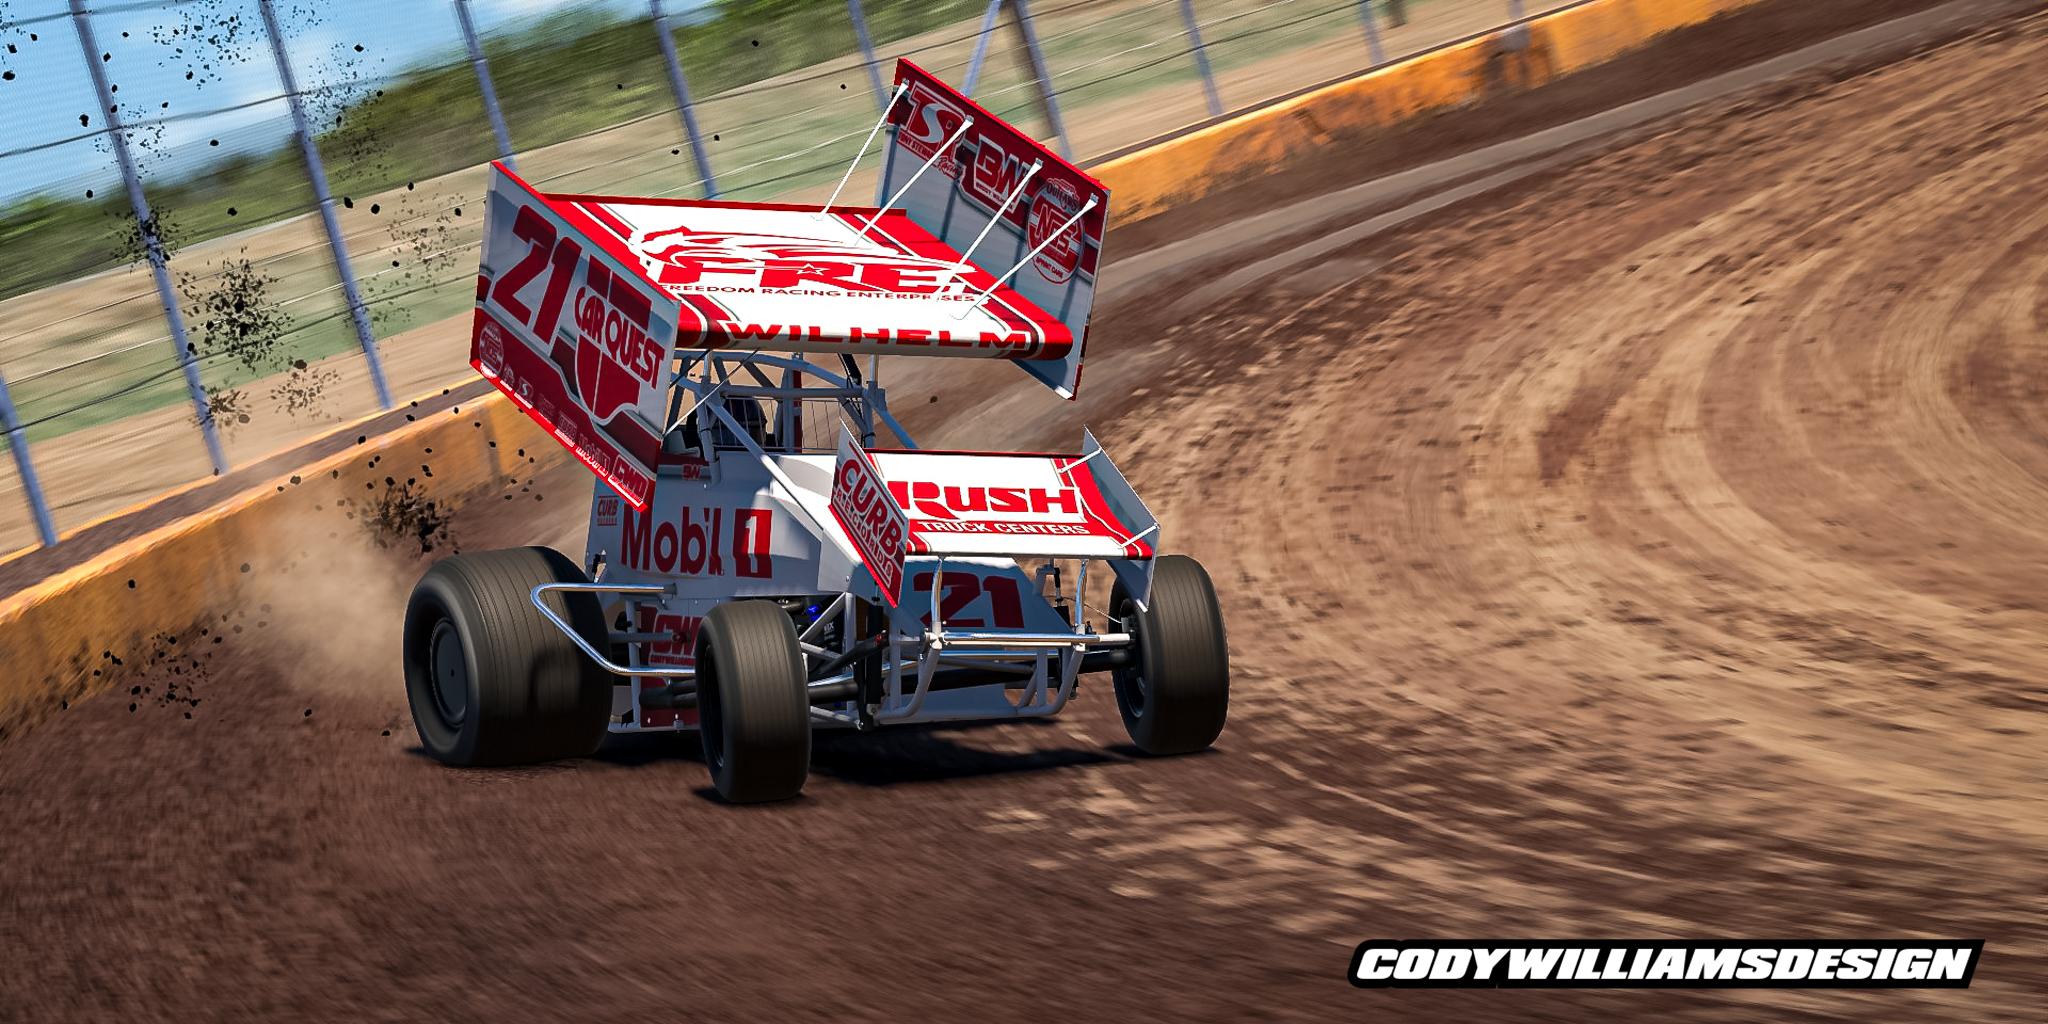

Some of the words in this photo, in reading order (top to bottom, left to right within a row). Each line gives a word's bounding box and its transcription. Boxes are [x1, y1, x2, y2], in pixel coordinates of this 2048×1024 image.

[492, 204, 583, 345] 21
[661, 284, 755, 294] FREEDOM
[762, 287, 842, 298] RACING
[847, 291, 975, 302] ENTERPRSES
[728, 322, 1028, 350] WILHELM
[836, 489, 893, 577] RECORDS
[840, 459, 903, 557] CURB
[917, 520, 991, 534] TRUCK
[993, 520, 1090, 535] CENTERS
[621, 506, 724, 576] Mobil
[911, 571, 1025, 629] 21
